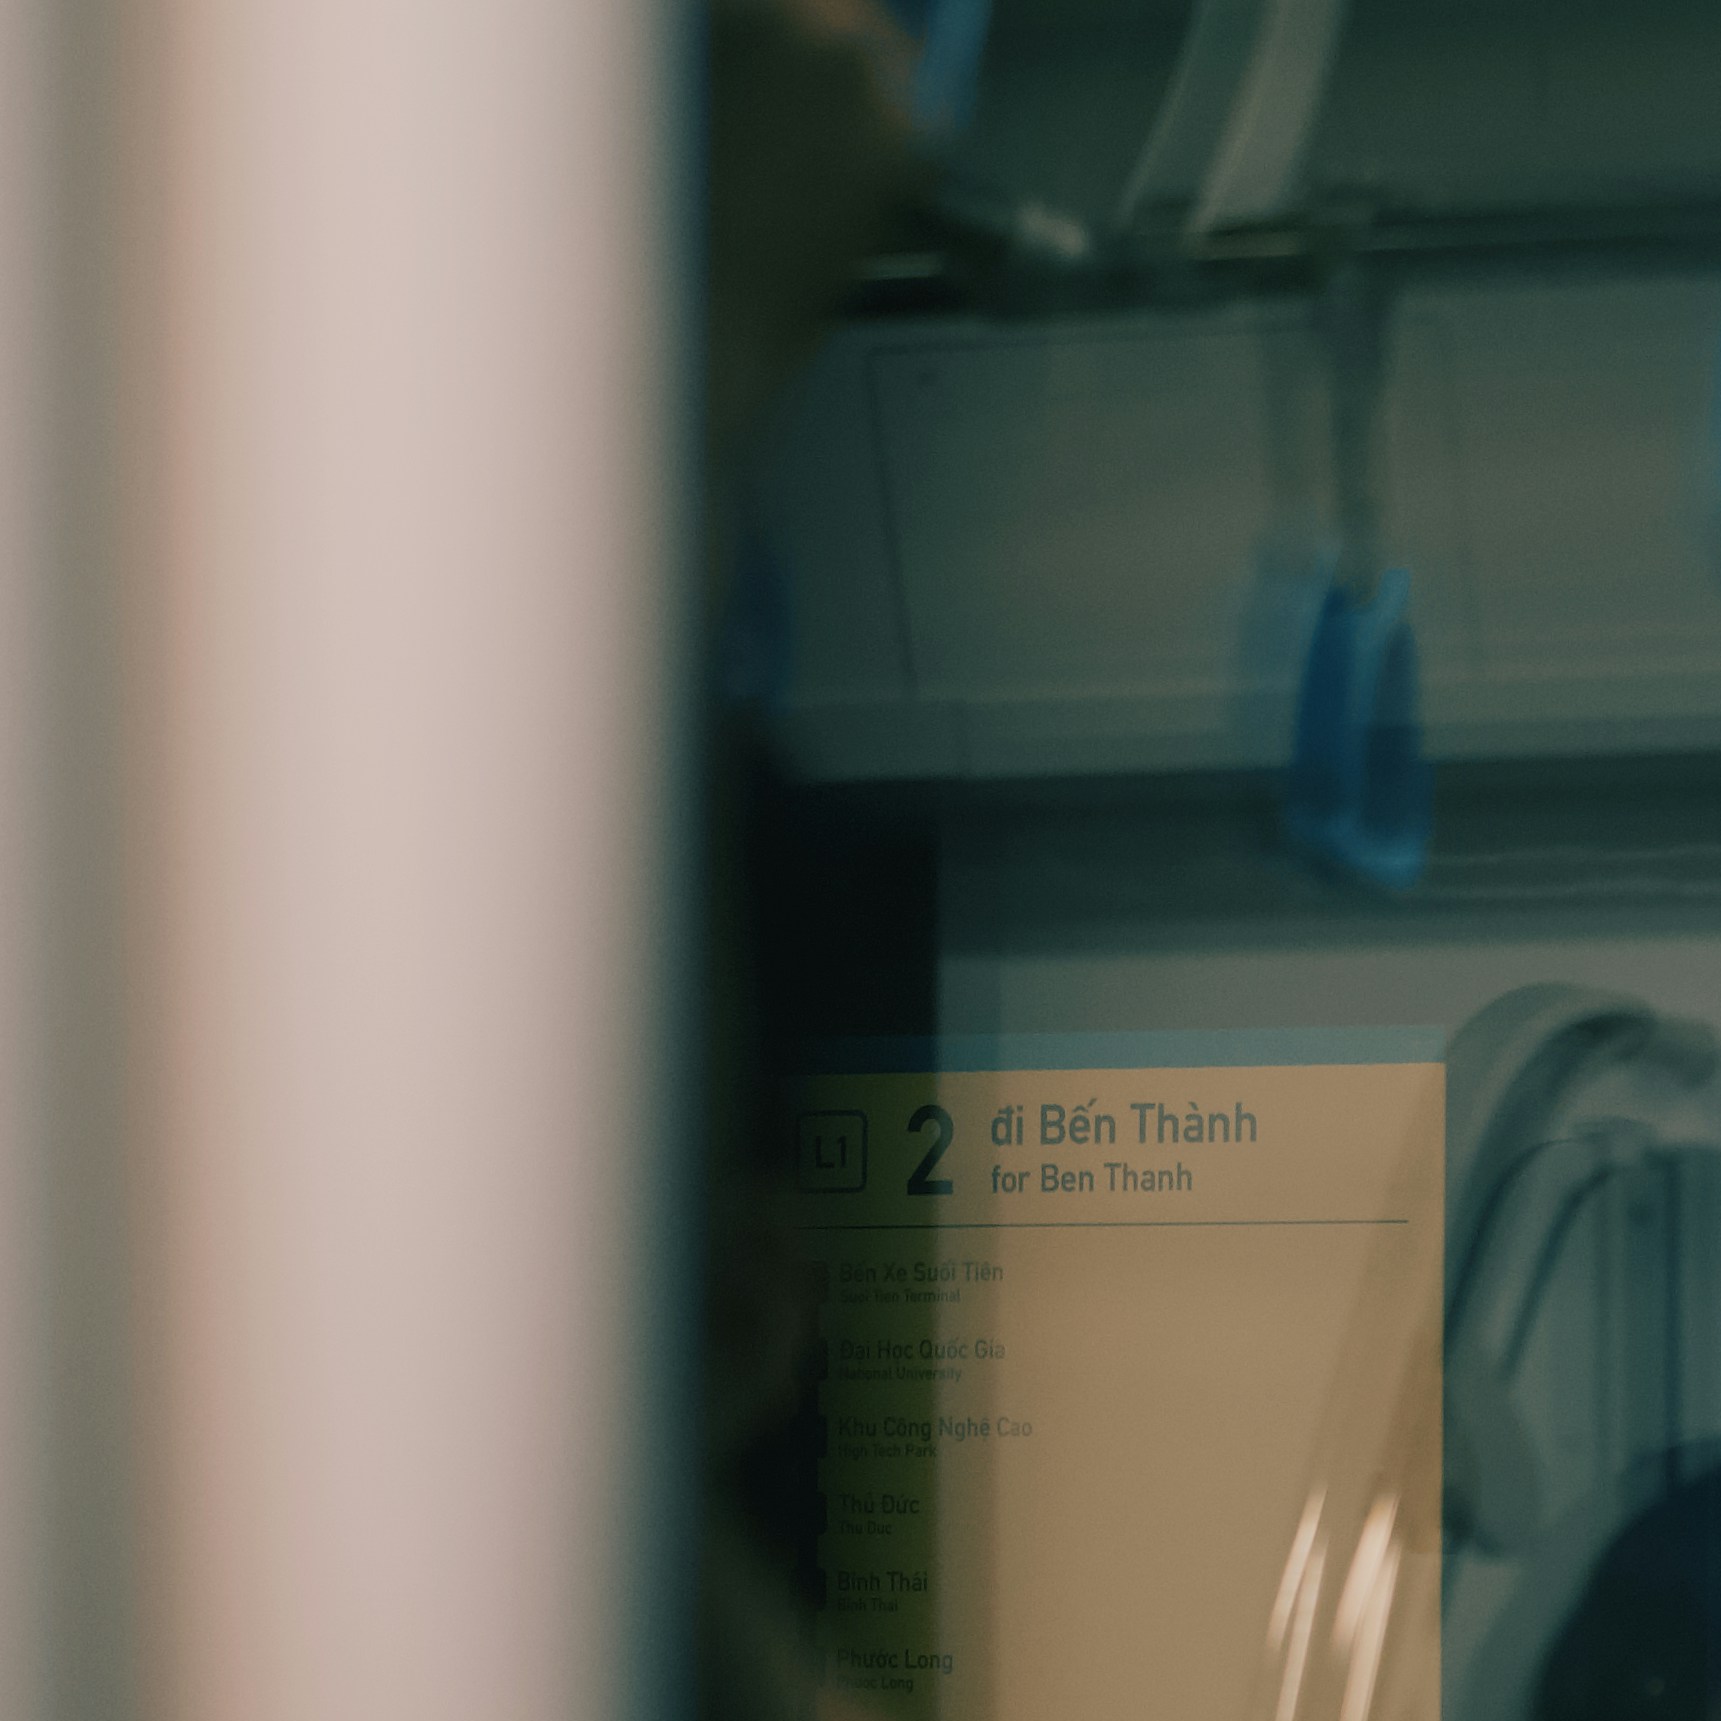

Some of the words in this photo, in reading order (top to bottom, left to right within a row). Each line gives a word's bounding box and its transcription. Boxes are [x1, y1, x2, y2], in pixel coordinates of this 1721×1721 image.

[990, 1105, 1025, 1146] đi
[1039, 1097, 1116, 1146] Bến
[1130, 1101, 1258, 1144] Thành
[906, 1103, 954, 1197] 2
[990, 1164, 1030, 1193] for
[1040, 1162, 1095, 1193] Ben
[1103, 1161, 1194, 1192] Thanh
[996, 1416, 1034, 1437] Cao
[904, 1648, 954, 1674] Long
